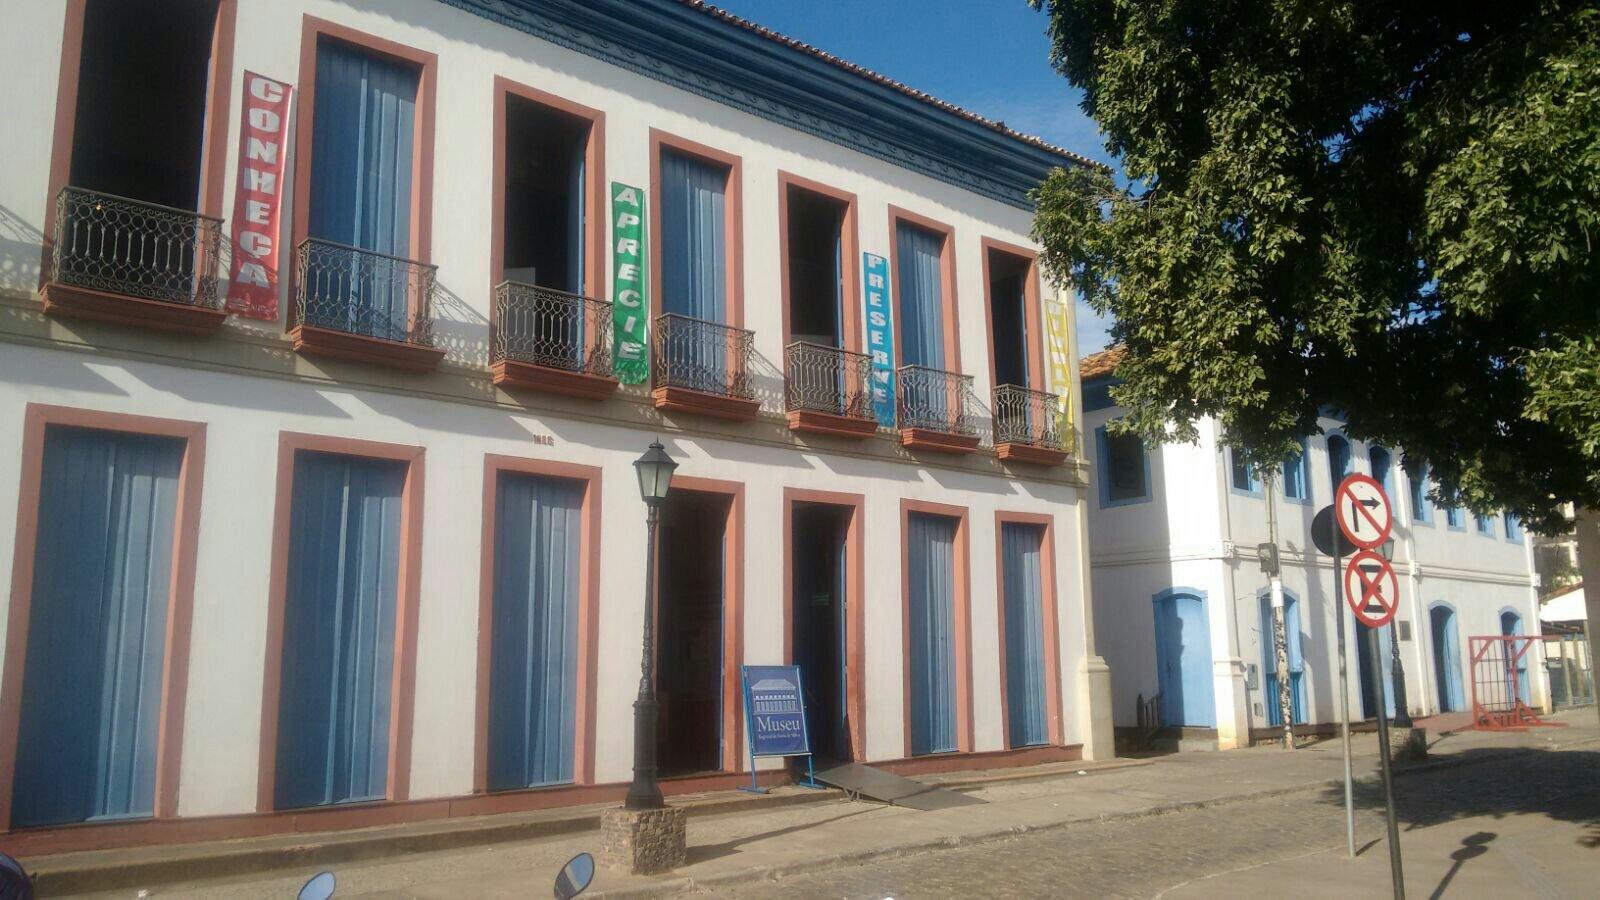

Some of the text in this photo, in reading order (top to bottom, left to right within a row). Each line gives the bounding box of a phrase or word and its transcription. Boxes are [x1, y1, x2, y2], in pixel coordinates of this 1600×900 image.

[236, 77, 284, 288] CONHEÇA
[614, 187, 642, 360] APRECIE
[867, 254, 890, 403] PRESERVE
[757, 716, 801, 732] Museu
